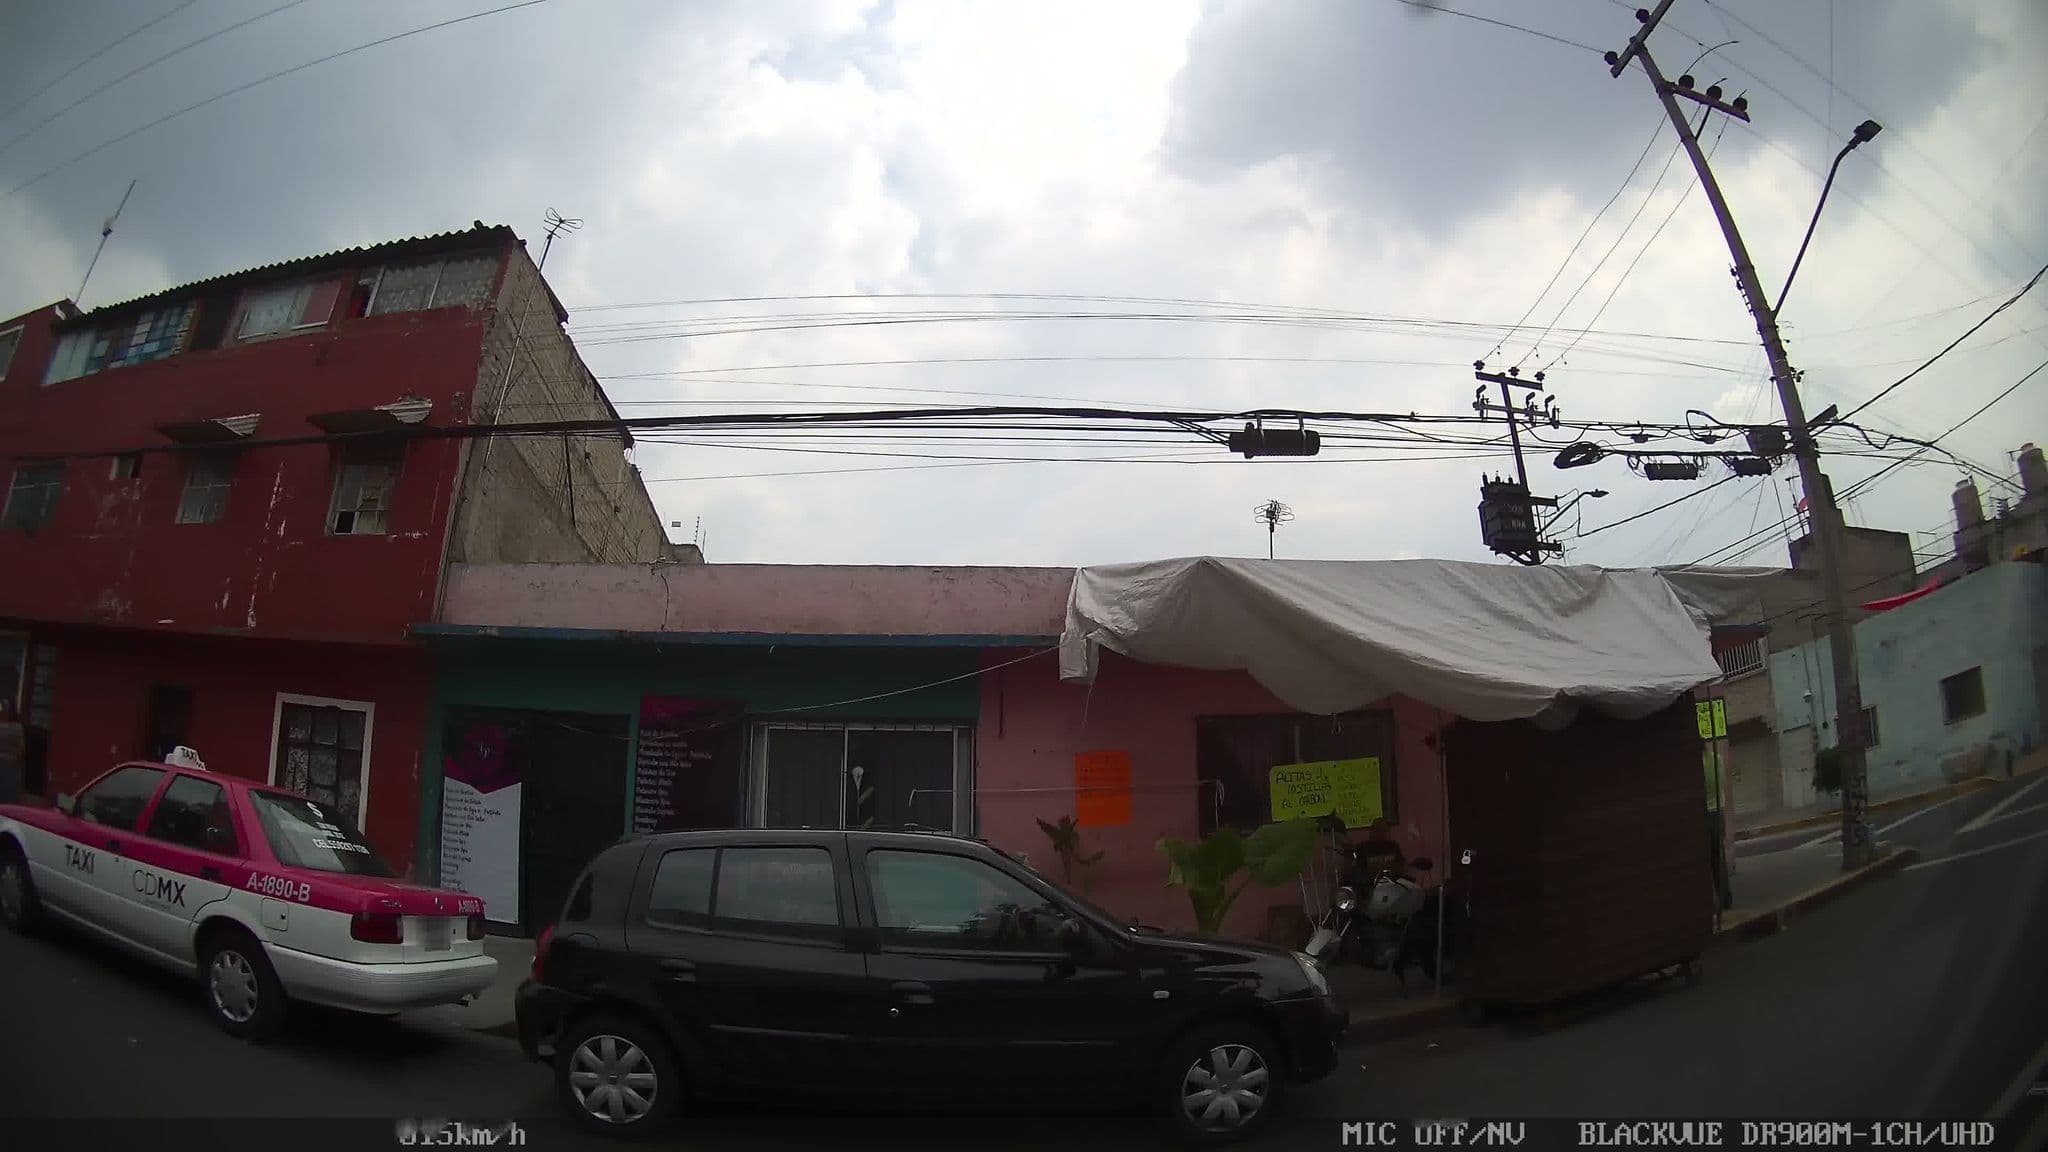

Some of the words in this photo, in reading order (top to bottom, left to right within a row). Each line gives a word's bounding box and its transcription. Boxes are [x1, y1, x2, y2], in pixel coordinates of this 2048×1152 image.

[65, 844, 95, 875] TAXI
[132, 869, 187, 908] CDMX
[245, 871, 311, 903] A-1890-B
